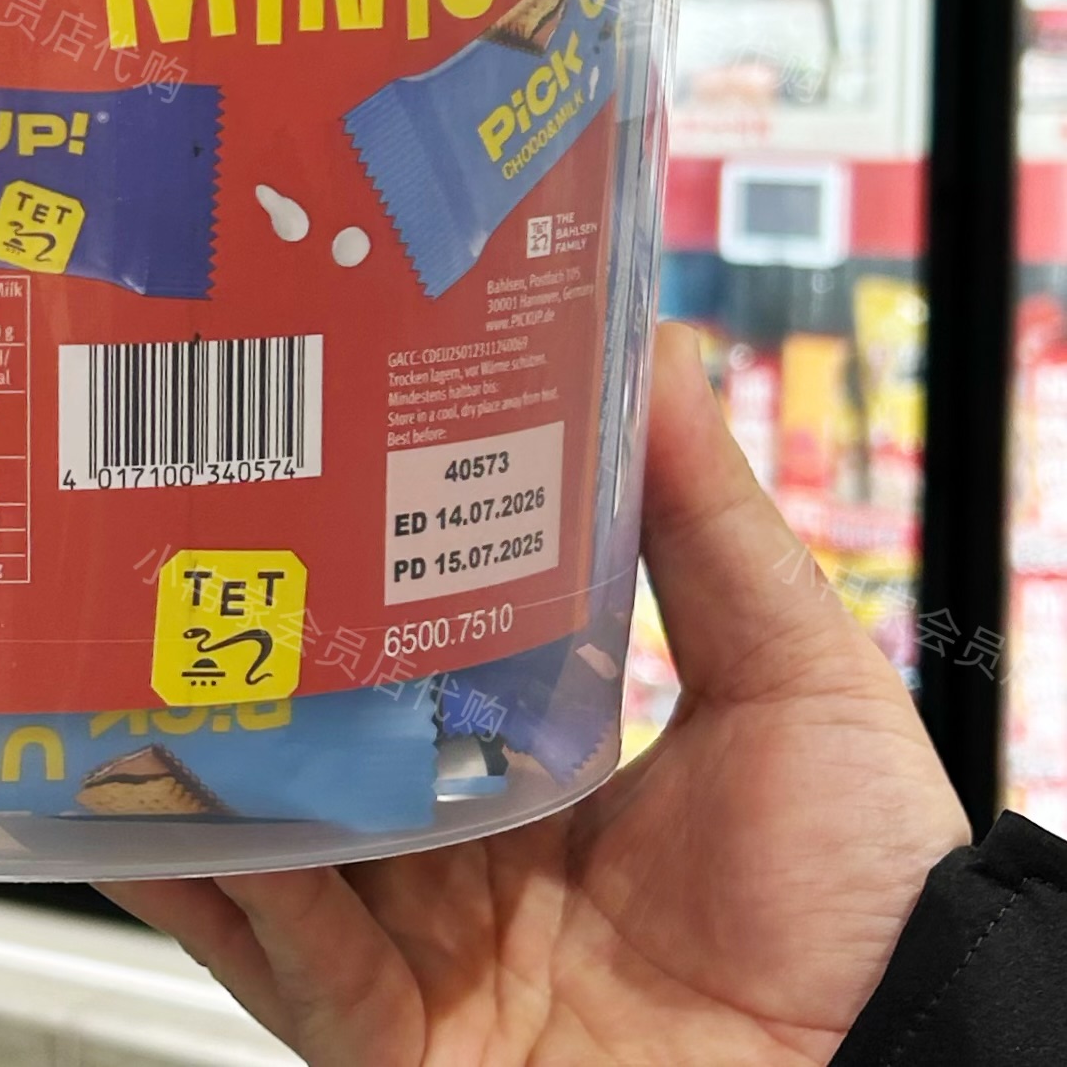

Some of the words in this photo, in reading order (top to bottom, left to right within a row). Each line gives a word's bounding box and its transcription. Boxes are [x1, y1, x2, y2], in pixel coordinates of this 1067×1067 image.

[16, 190, 73, 227] TET
[556, 212, 575, 224] THE
[555, 223, 598, 239] BAHLSEN
[555, 240, 587, 254] FAMILY
[5, 326, 14, 341] g
[63, 469, 76, 490] 4
[97, 464, 193, 489] 017100
[207, 459, 296, 485] 340574
[445, 451, 510, 482] 40573
[394, 511, 427, 537] ED
[436, 486, 545, 530] 14.07.2026
[394, 557, 426, 583] PD
[435, 530, 544, 575] 15.07.2025
[184, 571, 284, 616] TET
[384, 603, 514, 657] 6500.7510
